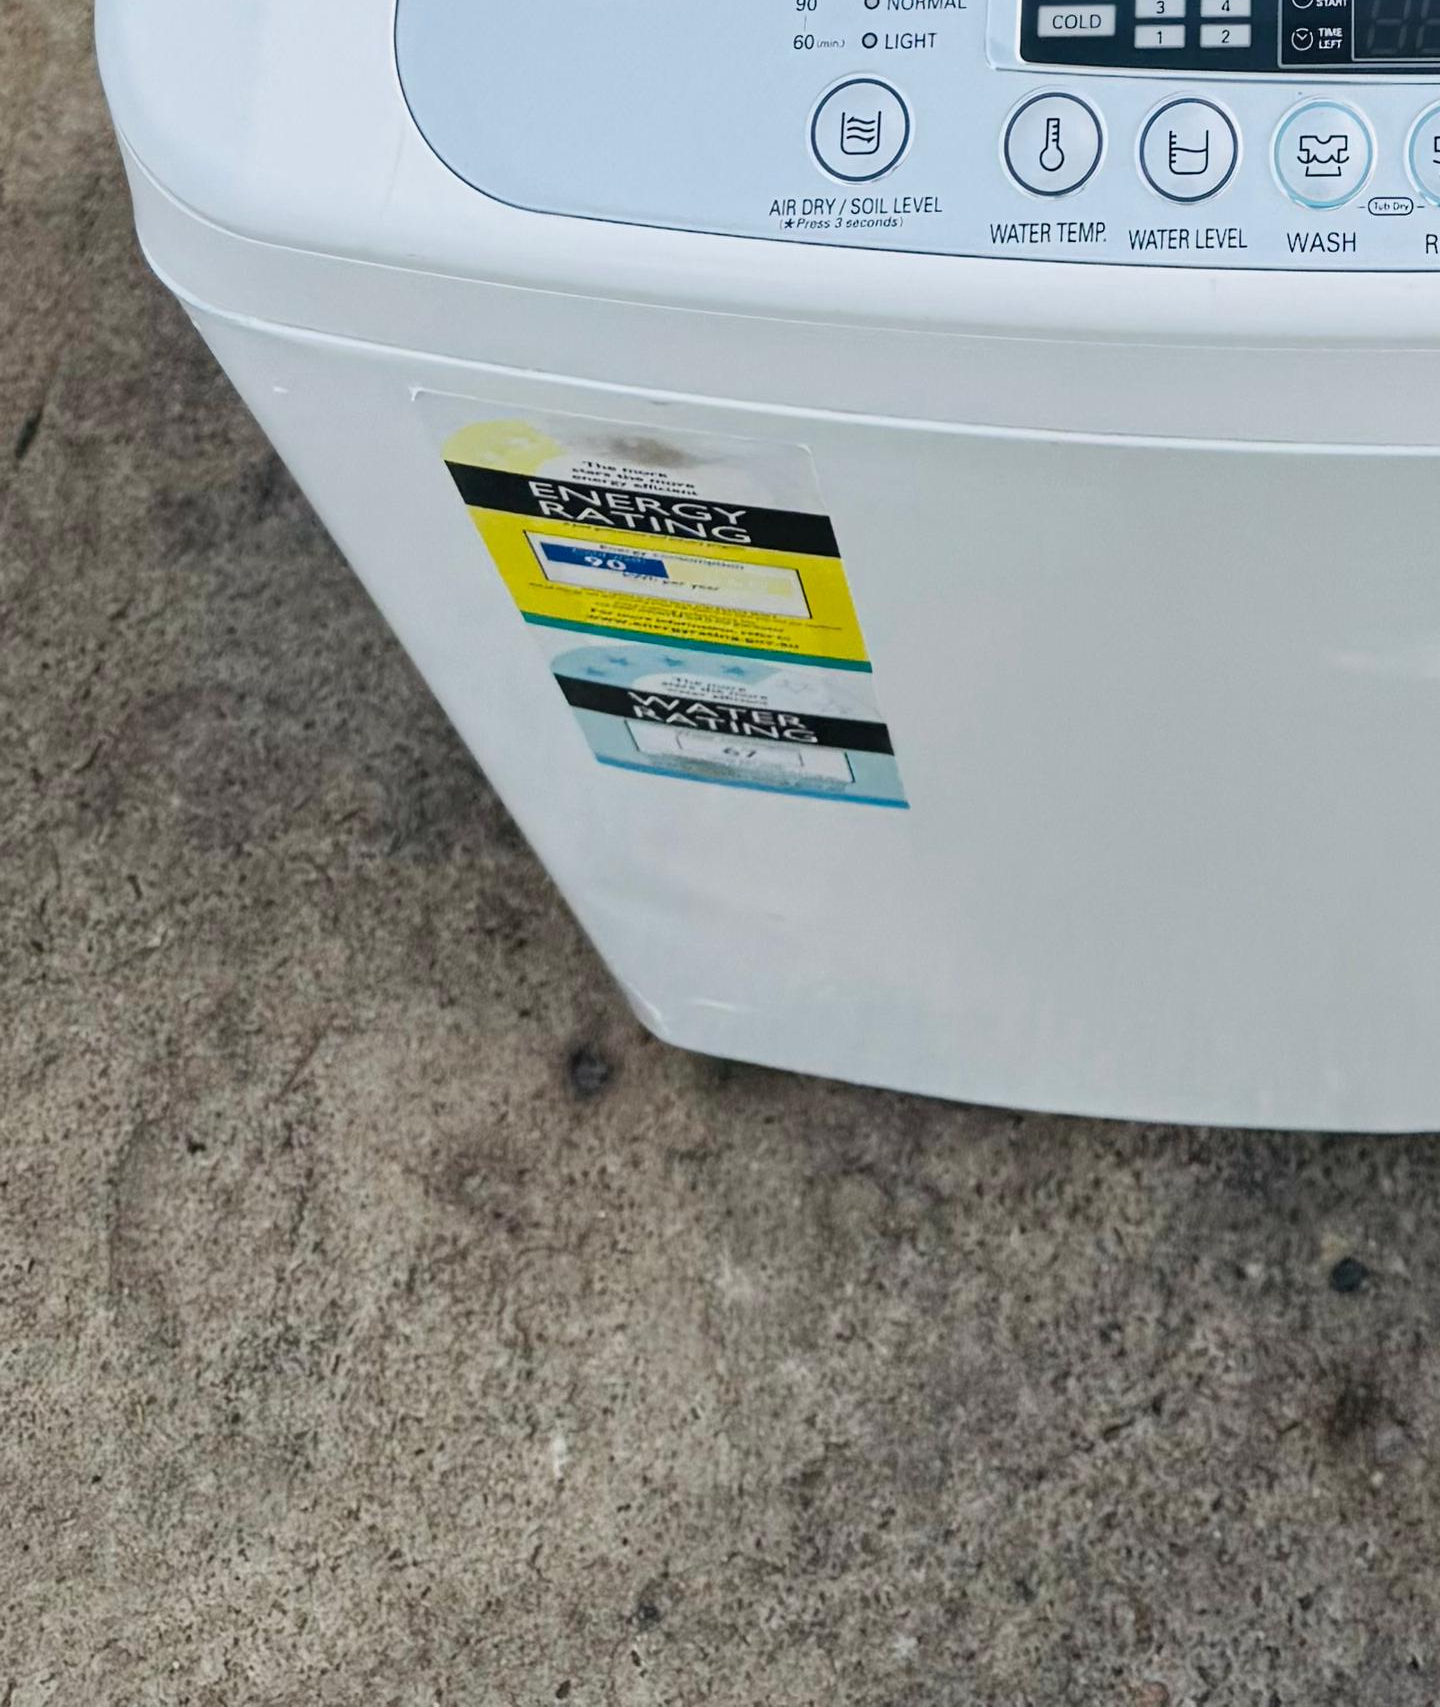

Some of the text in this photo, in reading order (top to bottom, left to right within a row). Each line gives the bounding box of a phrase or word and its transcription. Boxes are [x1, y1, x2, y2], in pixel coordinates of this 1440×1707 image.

[1156, 0, 1165, 14] 3
[1221, 0, 1230, 13] 4
[1052, 14, 1102, 30] COLD
[1156, 30, 1162, 44] 1
[1220, 29, 1230, 44] 2
[1318, 28, 1343, 38] TIME
[793, 34, 815, 50] 60
[884, 33, 937, 50] LIGHT
[1318, 39, 1342, 50] LEFT
[768, 199, 797, 216] AIR
[802, 198, 837, 215] DRY
[850, 197, 888, 215] SOIL
[893, 196, 943, 214] LEVEL
[834, 217, 842, 229] 3
[990, 222, 1107, 244] WATER TEMP.
[1129, 229, 1248, 250] WATER LEVEL
[1287, 232, 1357, 253] WASH
[528, 481, 747, 525] ENERGY
[540, 501, 752, 544] RATING
[628, 691, 806, 728] WATER
[633, 706, 818, 744] RATING
